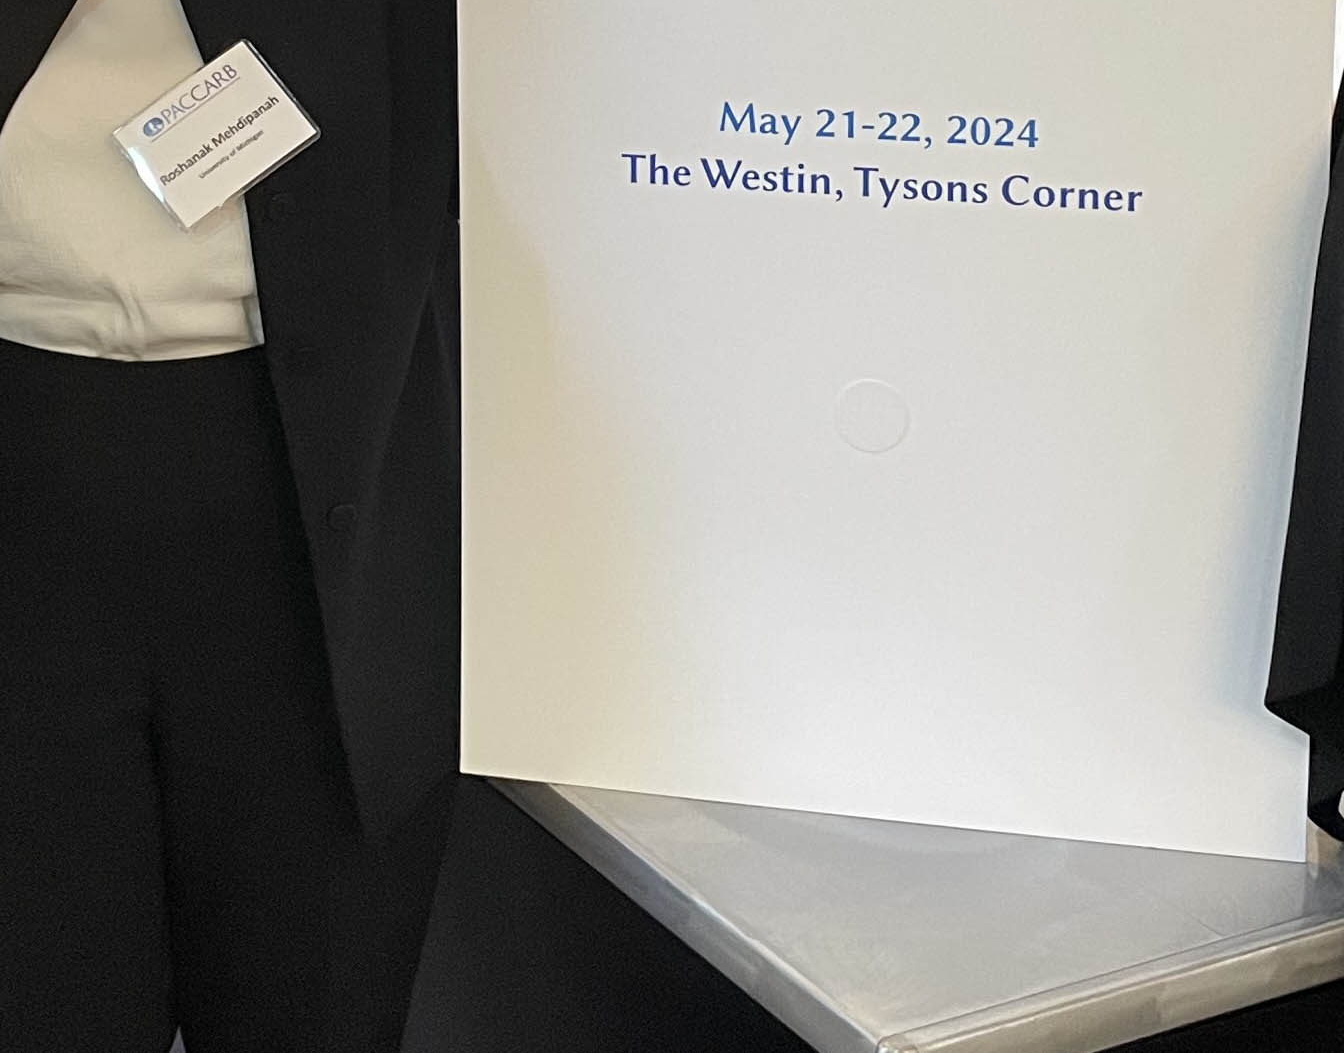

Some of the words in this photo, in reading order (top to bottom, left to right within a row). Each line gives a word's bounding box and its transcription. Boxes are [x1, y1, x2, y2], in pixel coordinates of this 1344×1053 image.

[160, 63, 238, 125] PACCARB
[159, 143, 213, 186] Roshanak
[211, 95, 280, 149] Mehdipanah
[719, 101, 802, 145] May
[815, 108, 933, 148] 21-22,
[946, 115, 1039, 148] 2024
[621, 153, 692, 187] The
[700, 158, 844, 202] Westin,
[853, 166, 989, 208] Tysons
[1001, 175, 1144, 212] Corner
